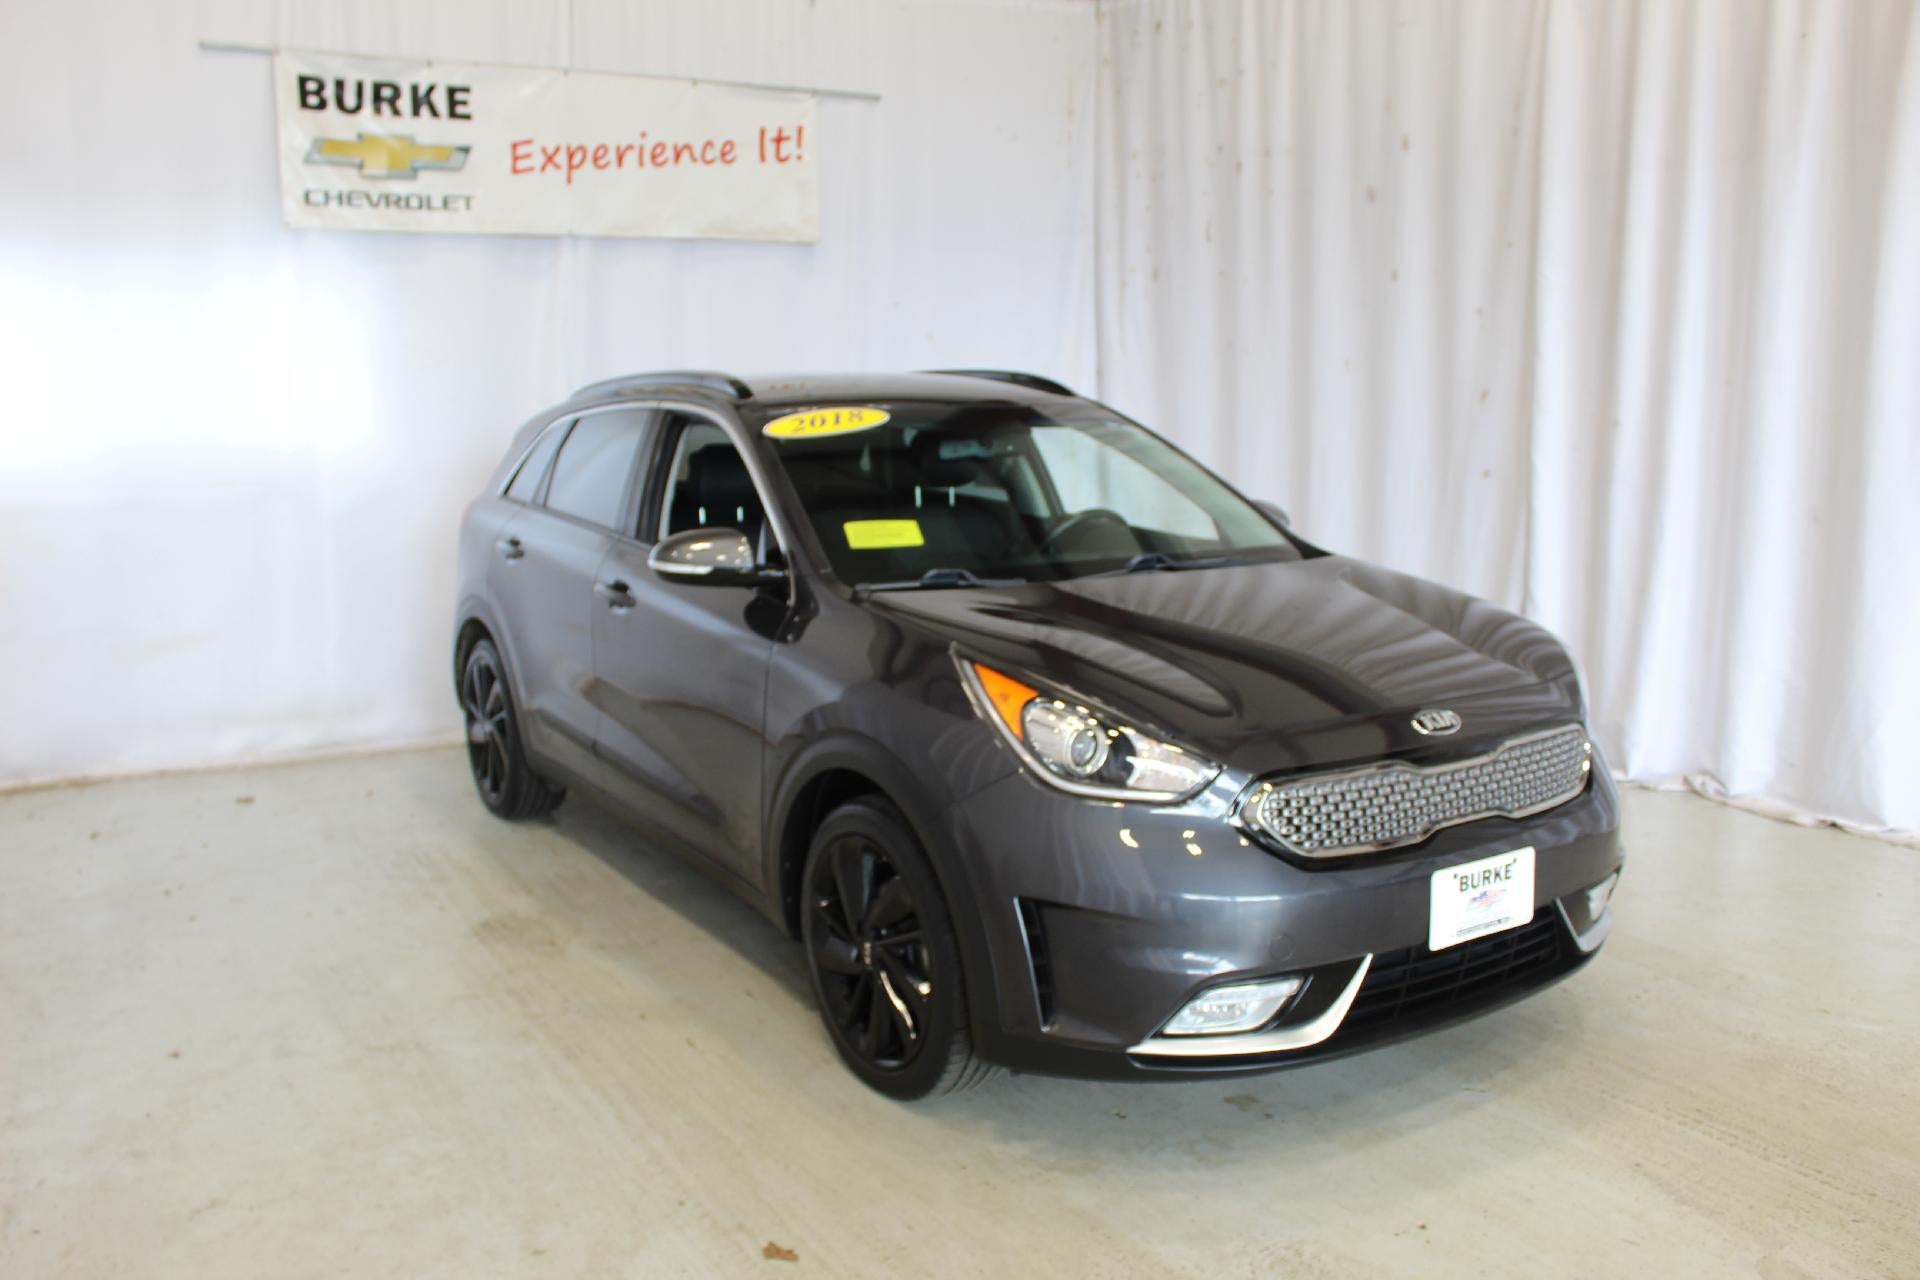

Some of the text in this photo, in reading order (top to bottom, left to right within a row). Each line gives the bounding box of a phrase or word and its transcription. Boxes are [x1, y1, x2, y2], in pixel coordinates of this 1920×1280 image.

[297, 73, 473, 121] BURKE
[509, 125, 806, 186] Experience It!
[303, 189, 475, 212] CHEVROLET
[791, 410, 864, 433] 2018
[1458, 863, 1513, 892] BURKE
